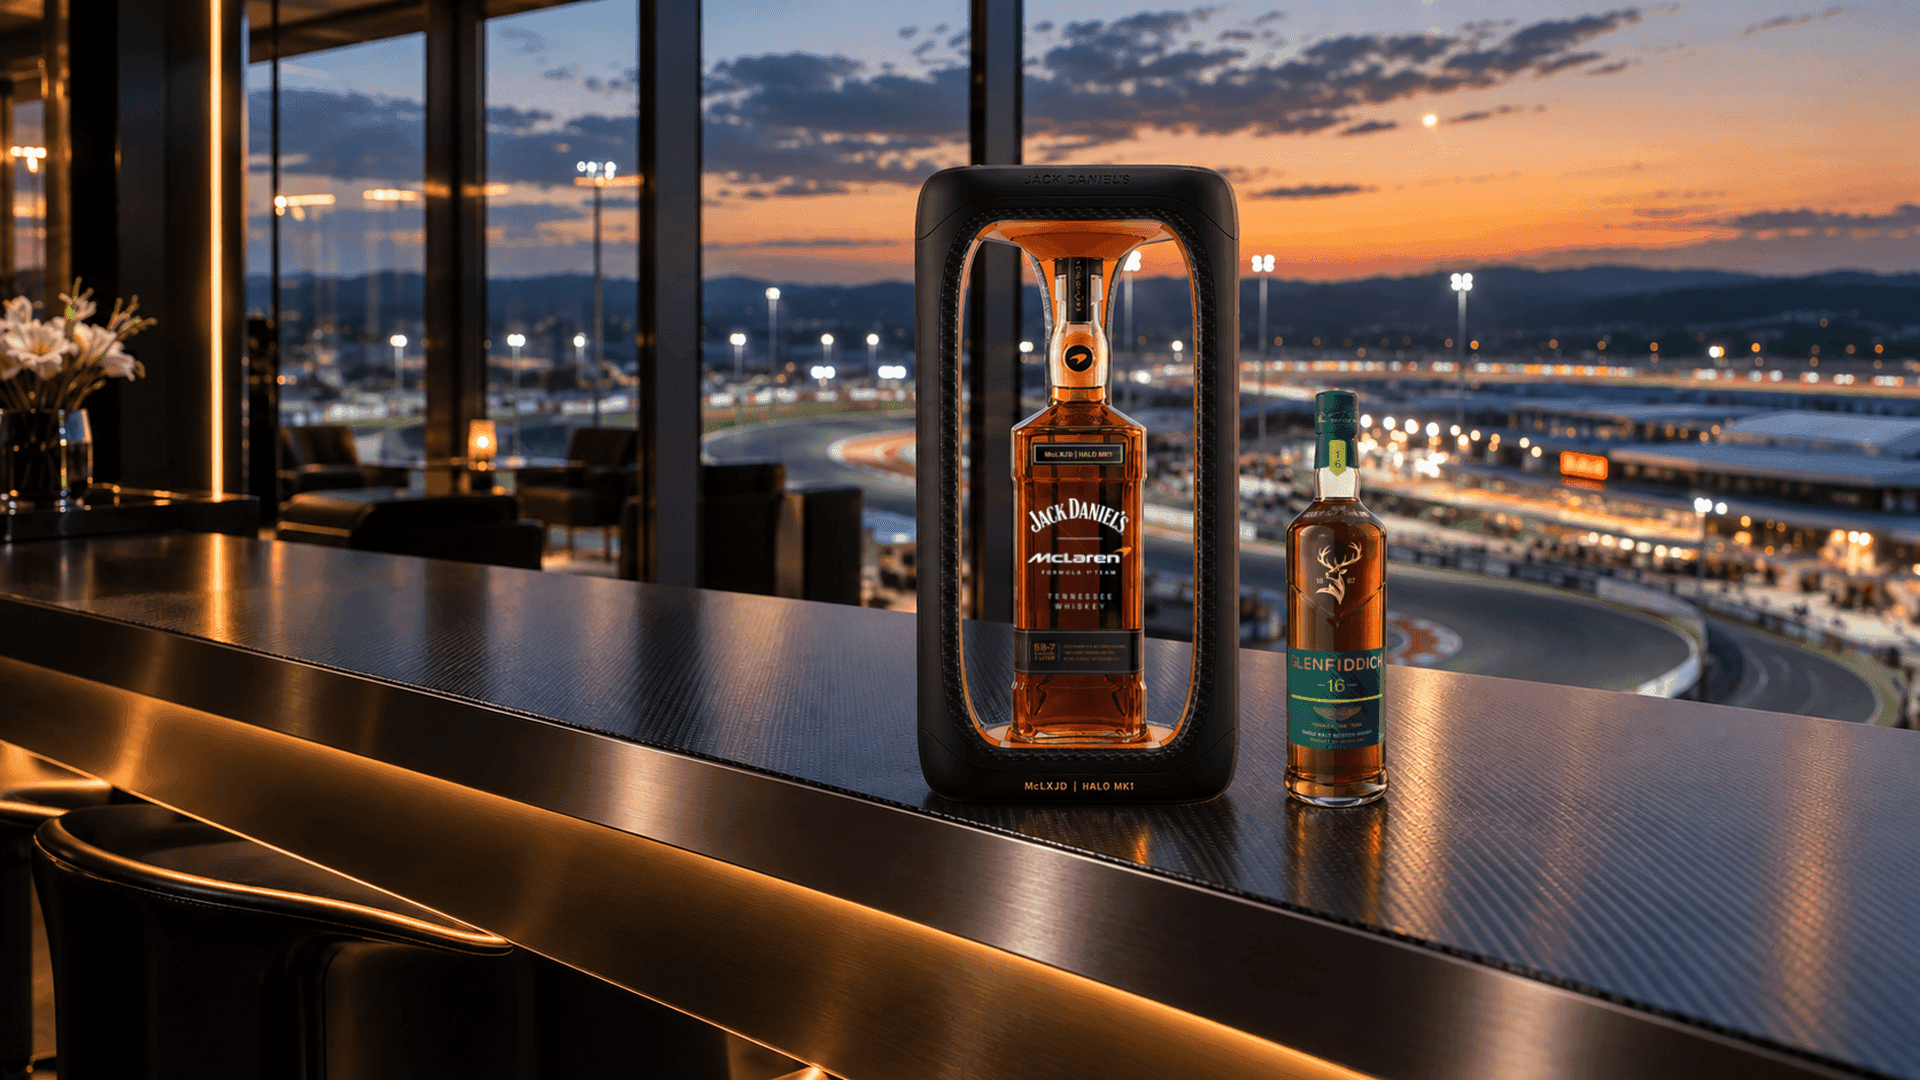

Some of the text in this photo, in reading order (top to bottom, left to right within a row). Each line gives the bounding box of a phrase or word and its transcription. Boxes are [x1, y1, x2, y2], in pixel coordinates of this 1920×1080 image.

[1024, 174, 1131, 185] JACK DANIEL'S
[1028, 497, 1130, 534] JACK DANIEL'S
[1027, 552, 1120, 564] McLaren
[1047, 592, 1113, 600] TENNESSEE
[1290, 652, 1383, 672] GLENFIDDICH
[1024, 781, 1068, 791] McLXJD
[1082, 781, 1111, 791] HALO
[1113, 781, 1135, 791] MK1
